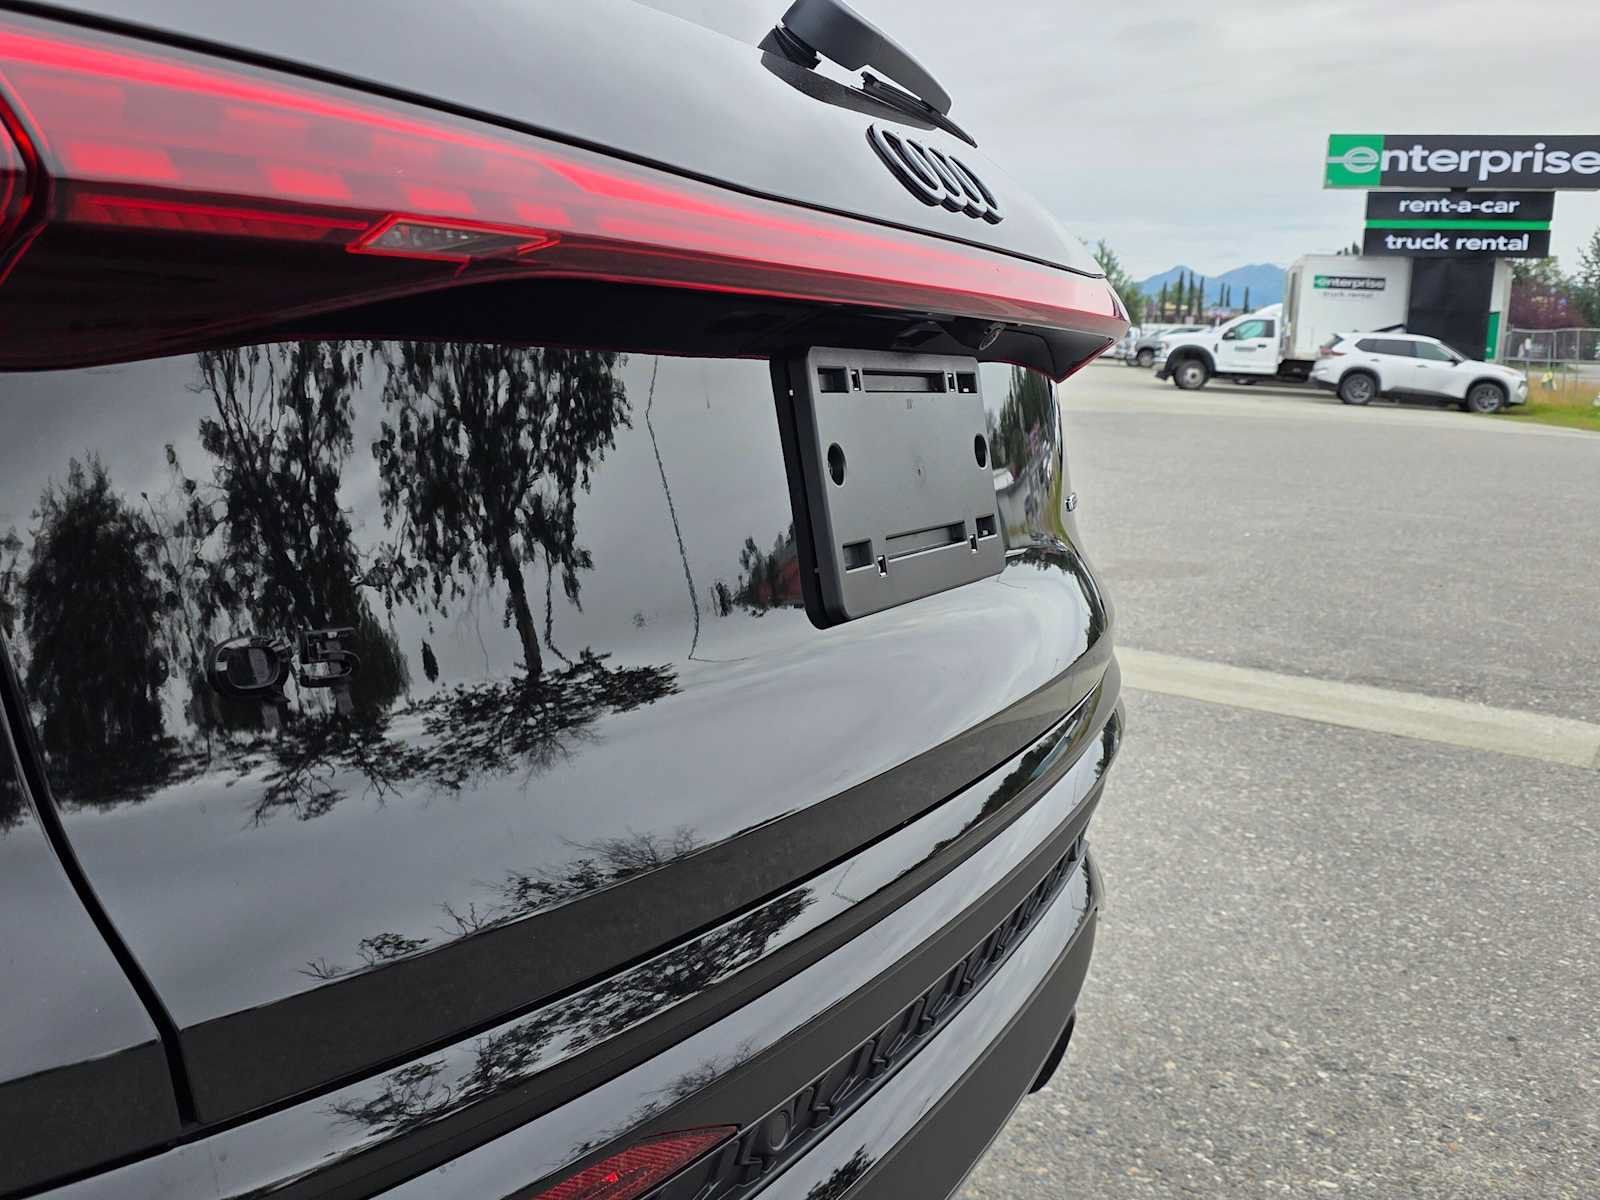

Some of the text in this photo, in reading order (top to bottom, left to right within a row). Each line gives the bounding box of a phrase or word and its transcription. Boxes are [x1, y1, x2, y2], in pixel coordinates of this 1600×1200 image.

[1330, 143, 1600, 181] enterprise
[1399, 197, 1521, 214] rent-a-car
[1384, 232, 1530, 252] truck rental
[1315, 276, 1385, 290] enterprise
[207, 627, 361, 702] Q5
